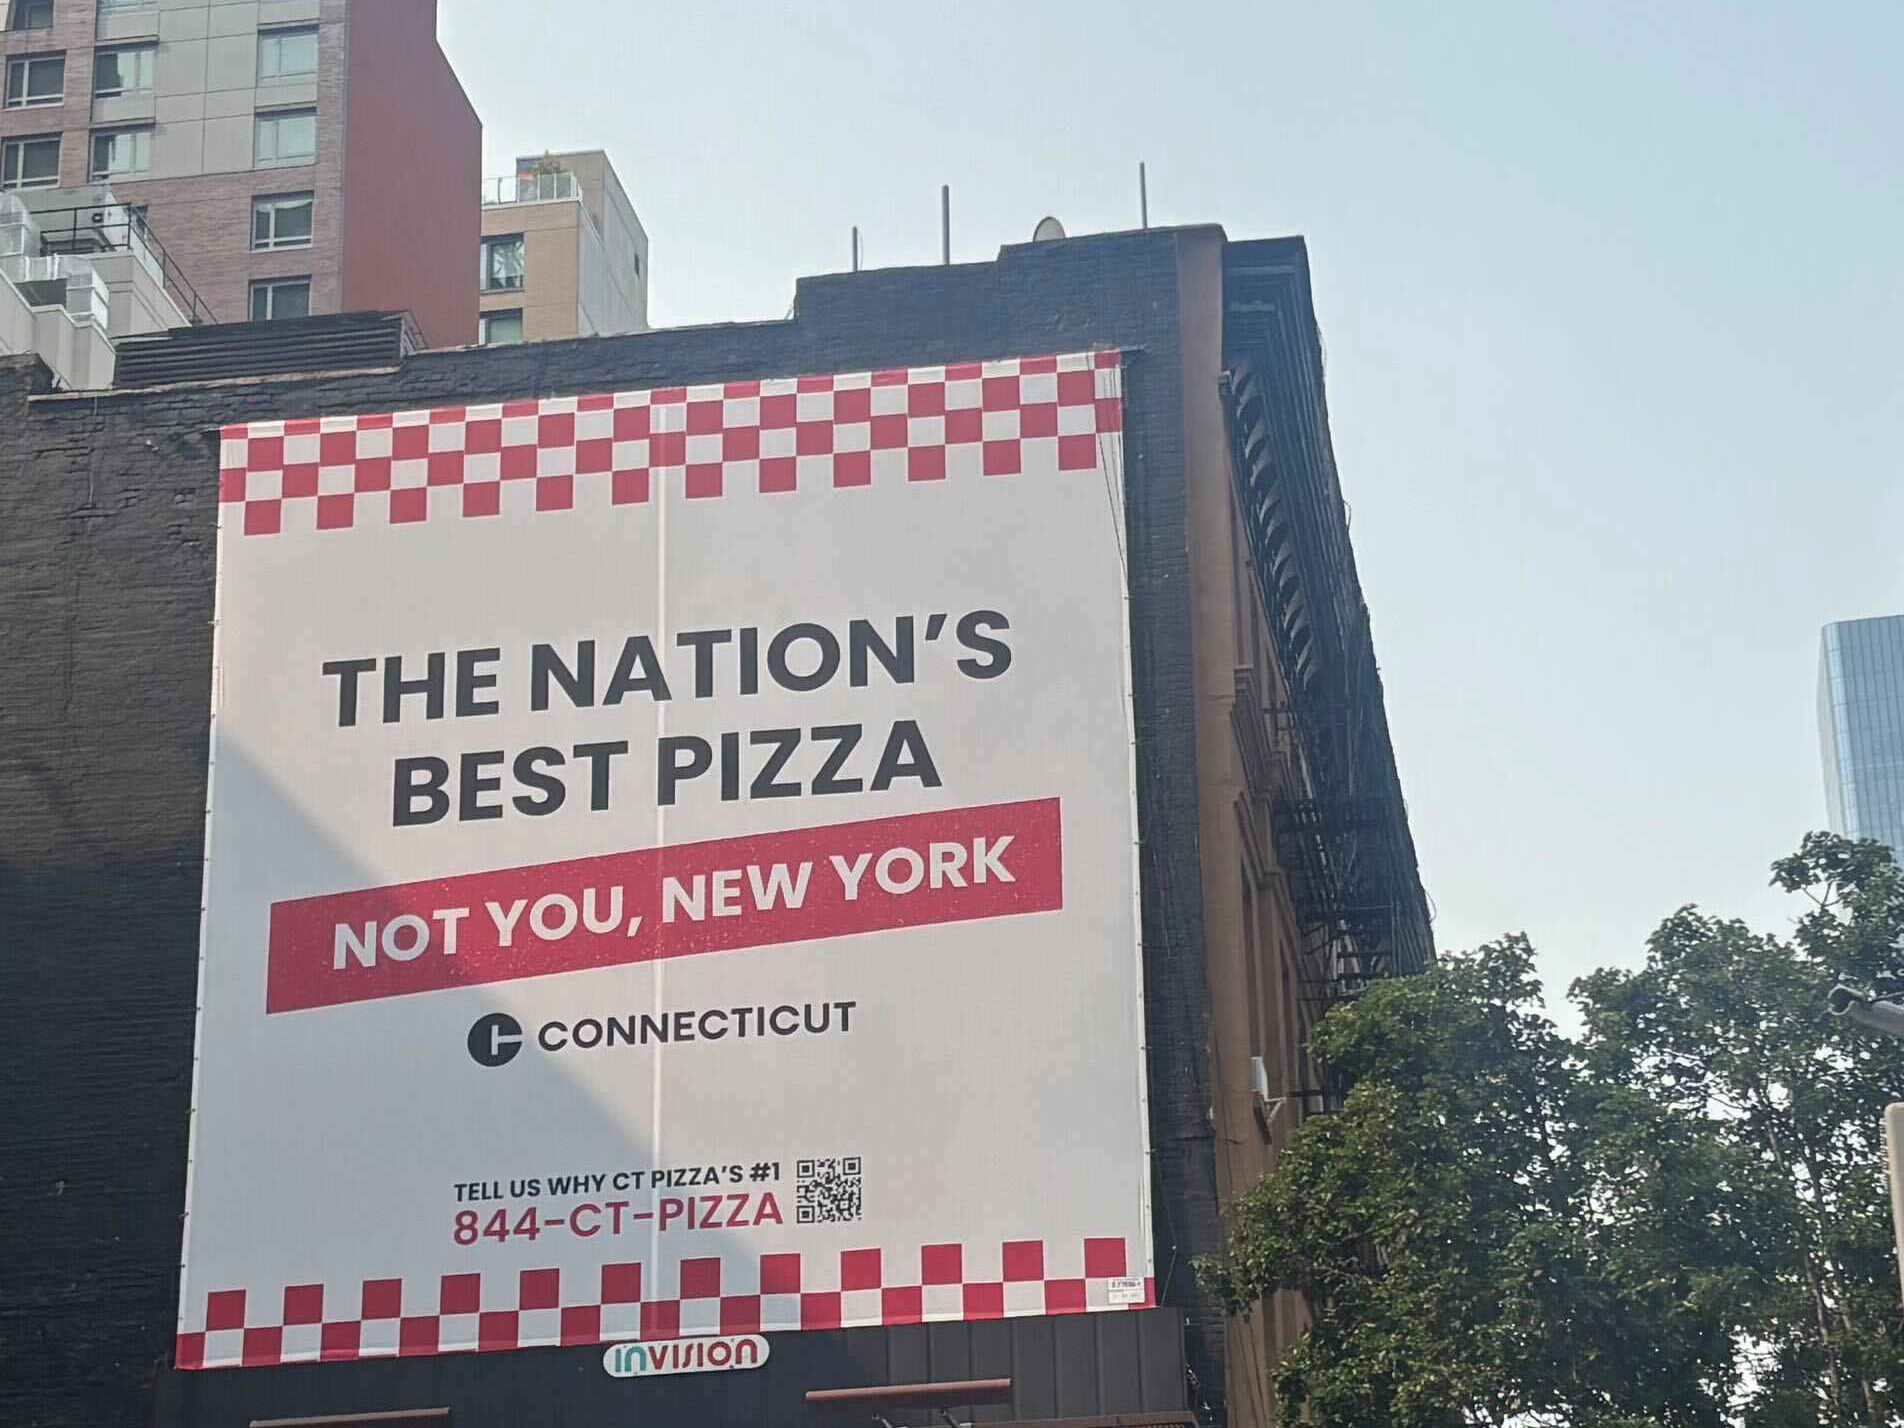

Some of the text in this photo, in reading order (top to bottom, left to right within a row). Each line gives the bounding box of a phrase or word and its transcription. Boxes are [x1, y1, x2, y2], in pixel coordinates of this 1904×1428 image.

[322, 610, 1012, 727] THE NATION'S
[393, 720, 942, 826] BEST PIZZA
[333, 836, 1016, 970] NOT YOU, NEW YORK
[538, 1001, 856, 1052] CONNECTICUT
[453, 1191, 784, 1246] 844-CT-PIZZA
[454, 1161, 780, 1202] TELL US WHY CT PIZZA'S #1
